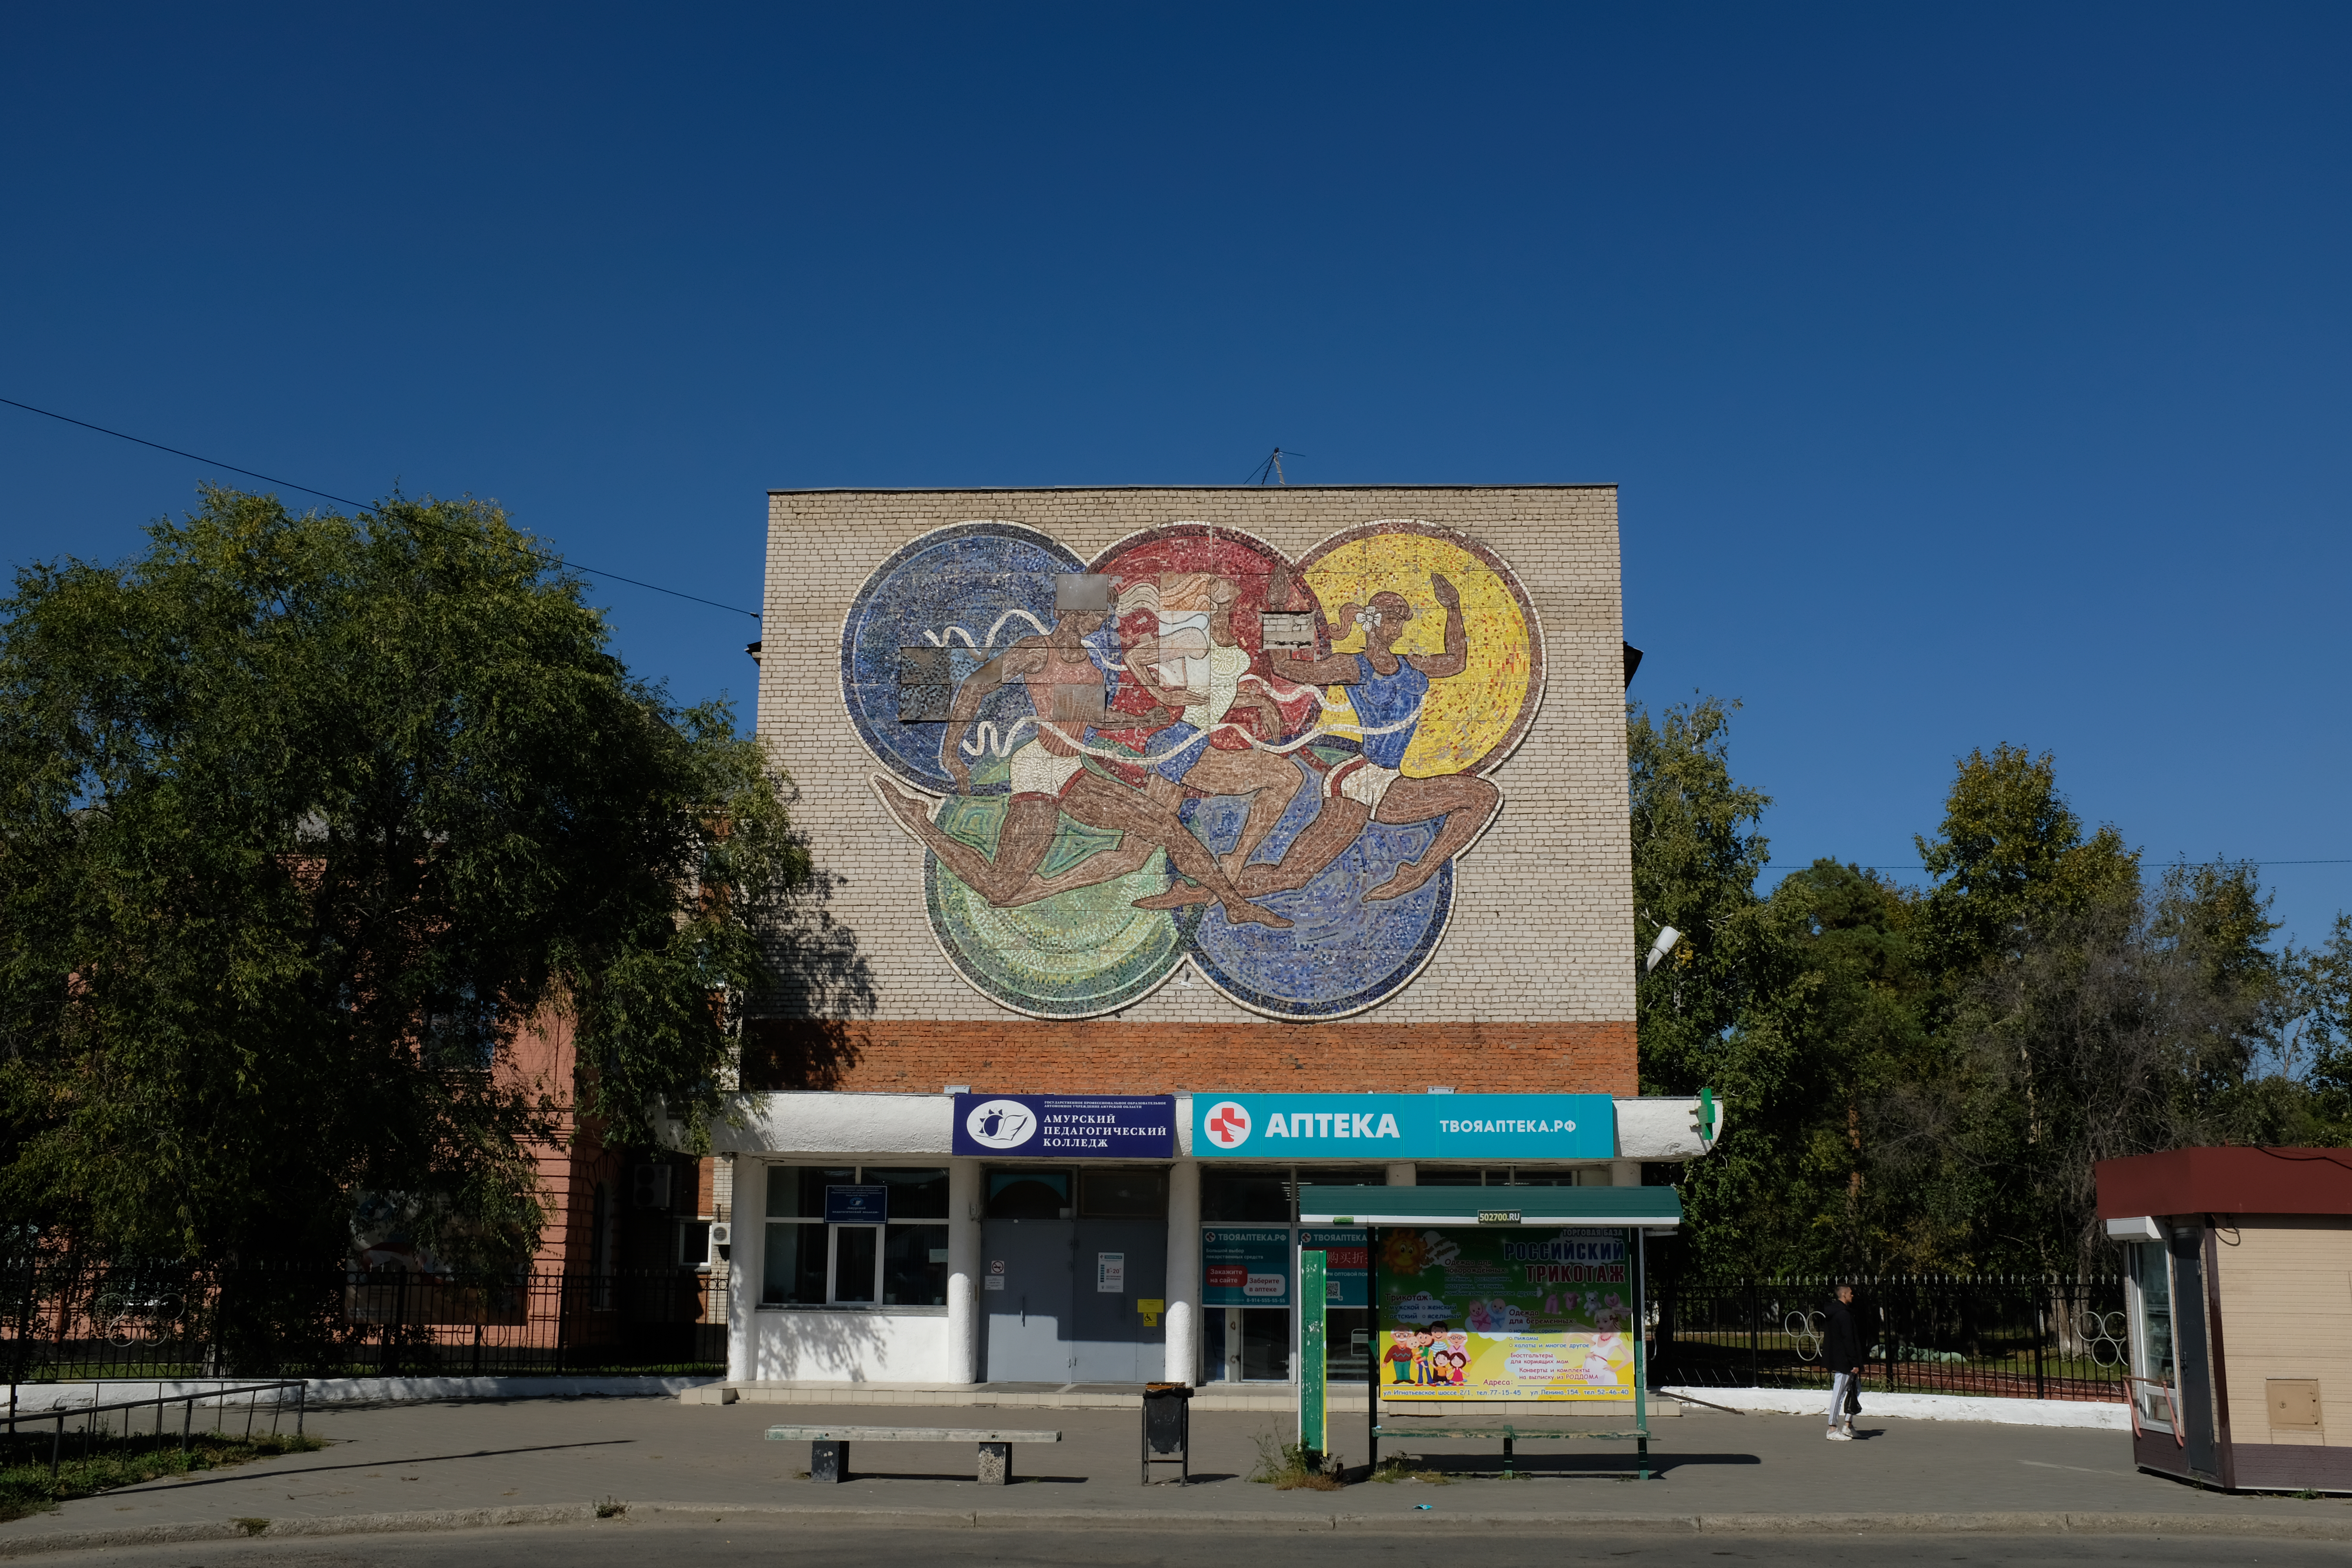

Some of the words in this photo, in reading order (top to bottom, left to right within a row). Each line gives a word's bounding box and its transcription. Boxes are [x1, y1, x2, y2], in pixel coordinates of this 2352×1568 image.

[1044, 1114, 1116, 1124] АМУРСКИЙ
[1044, 1125, 1167, 1136] ПЕДАГОГИЧЕСКИЙ
[1265, 1113, 1400, 1138] АПТЕКА
[1439, 1120, 1576, 1133] ТВОЯАПТЕКА.РФ
[1043, 1138, 1108, 1148] КОЛЛЕДЖ
[1479, 1213, 1520, 1221] 502700.RU
[1563, 1229, 1601, 1237] ТОРГОВАЯ
[1504, 1240, 1624, 1261] РОССИЙСКИЙ
[1524, 1264, 1625, 1283] ТРИКОТАЖ
[1384, 1293, 1431, 1303] Трикотаж:
[1526, 1318, 1577, 1326] беременных:
[1483, 1379, 1513, 1387] Адреса:
